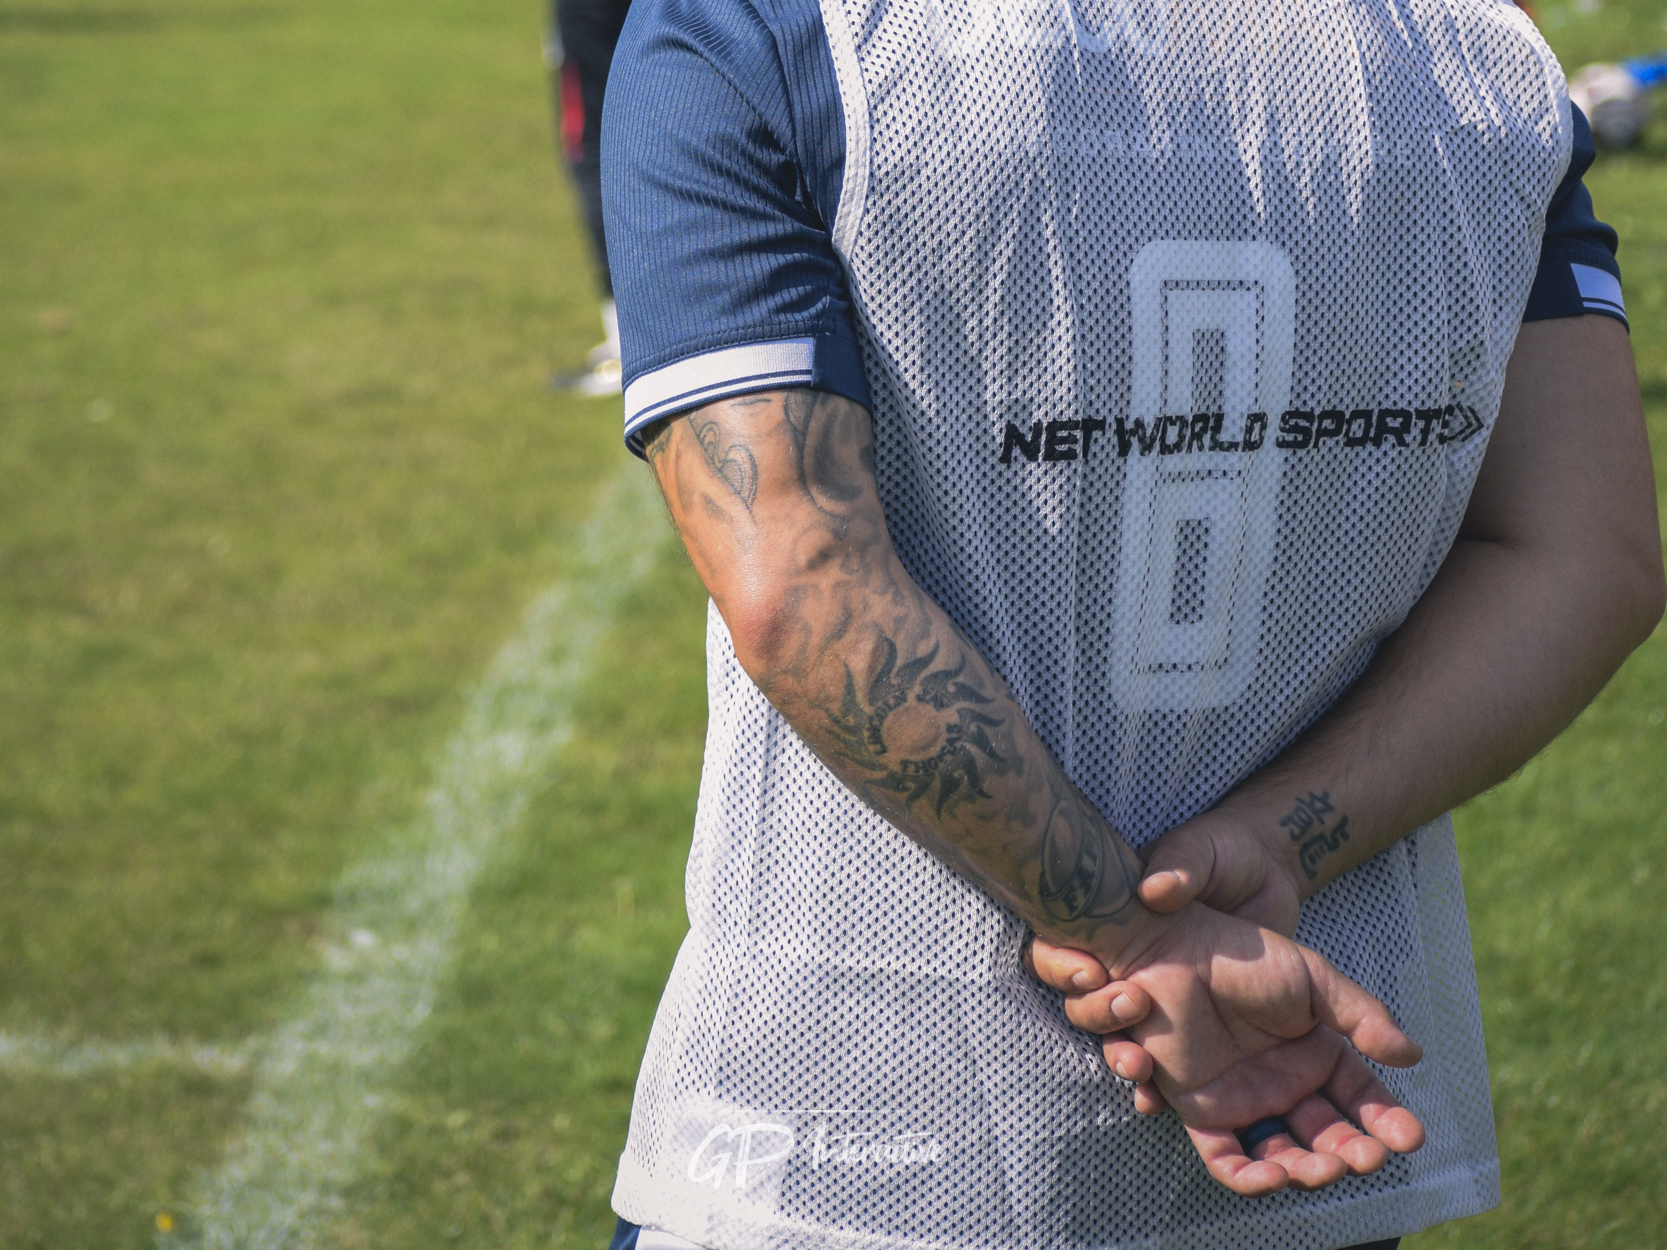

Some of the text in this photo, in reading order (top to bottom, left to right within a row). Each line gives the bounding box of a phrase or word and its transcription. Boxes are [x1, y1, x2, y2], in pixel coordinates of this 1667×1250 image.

[999, 404, 1454, 464] NET WORLD SPORTS
[1110, 240, 1297, 712] 8
